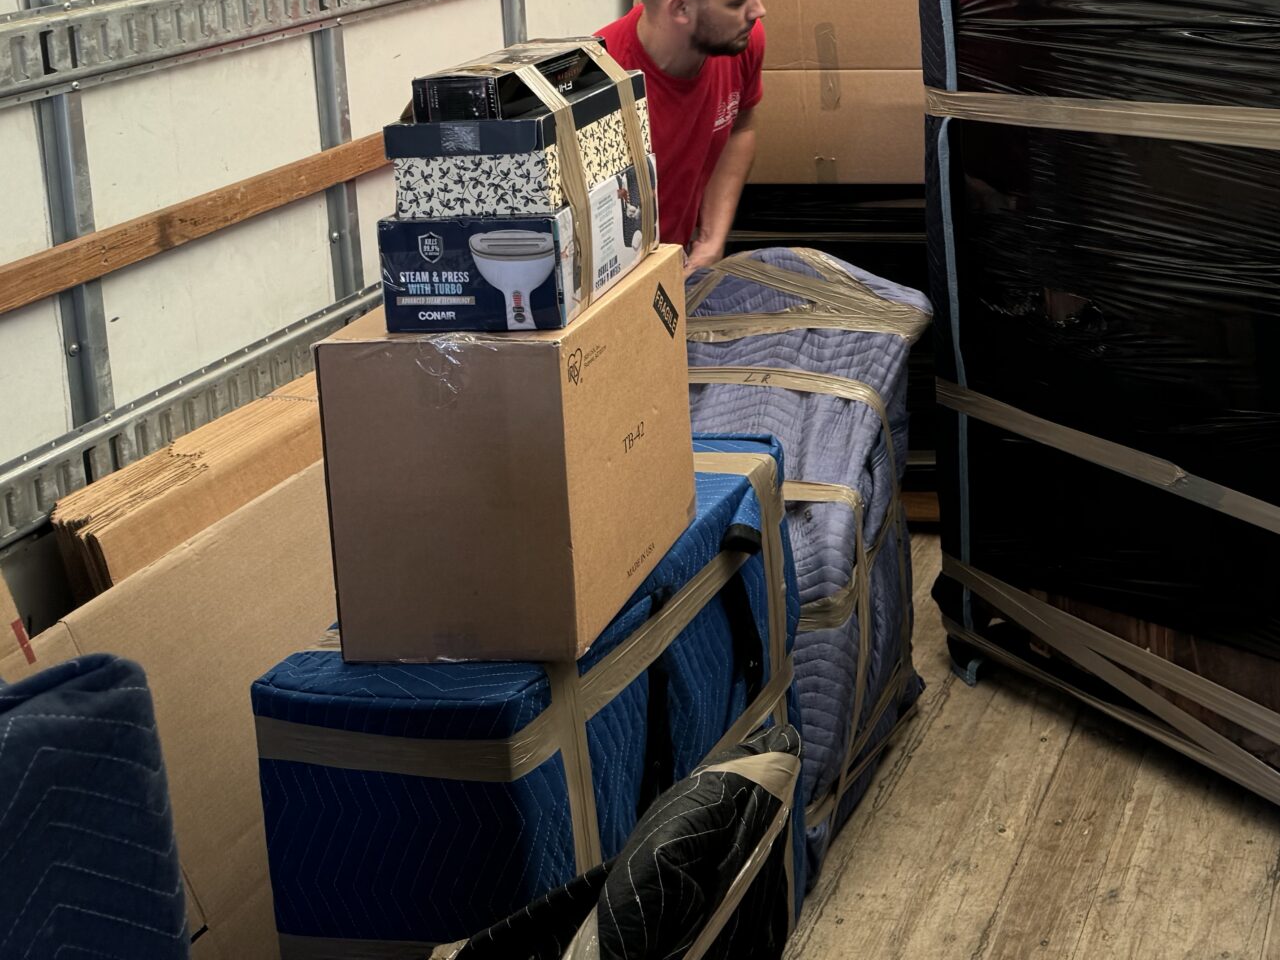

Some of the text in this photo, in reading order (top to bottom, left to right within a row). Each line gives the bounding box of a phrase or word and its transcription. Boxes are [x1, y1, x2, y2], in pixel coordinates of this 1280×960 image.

[400, 272, 469, 282] STEAM & PRESS
[408, 283, 462, 294] WITH TURBO
[418, 311, 456, 320] CONAIR
[655, 290, 677, 333] FRAGILE
[622, 421, 645, 453] TB-42
